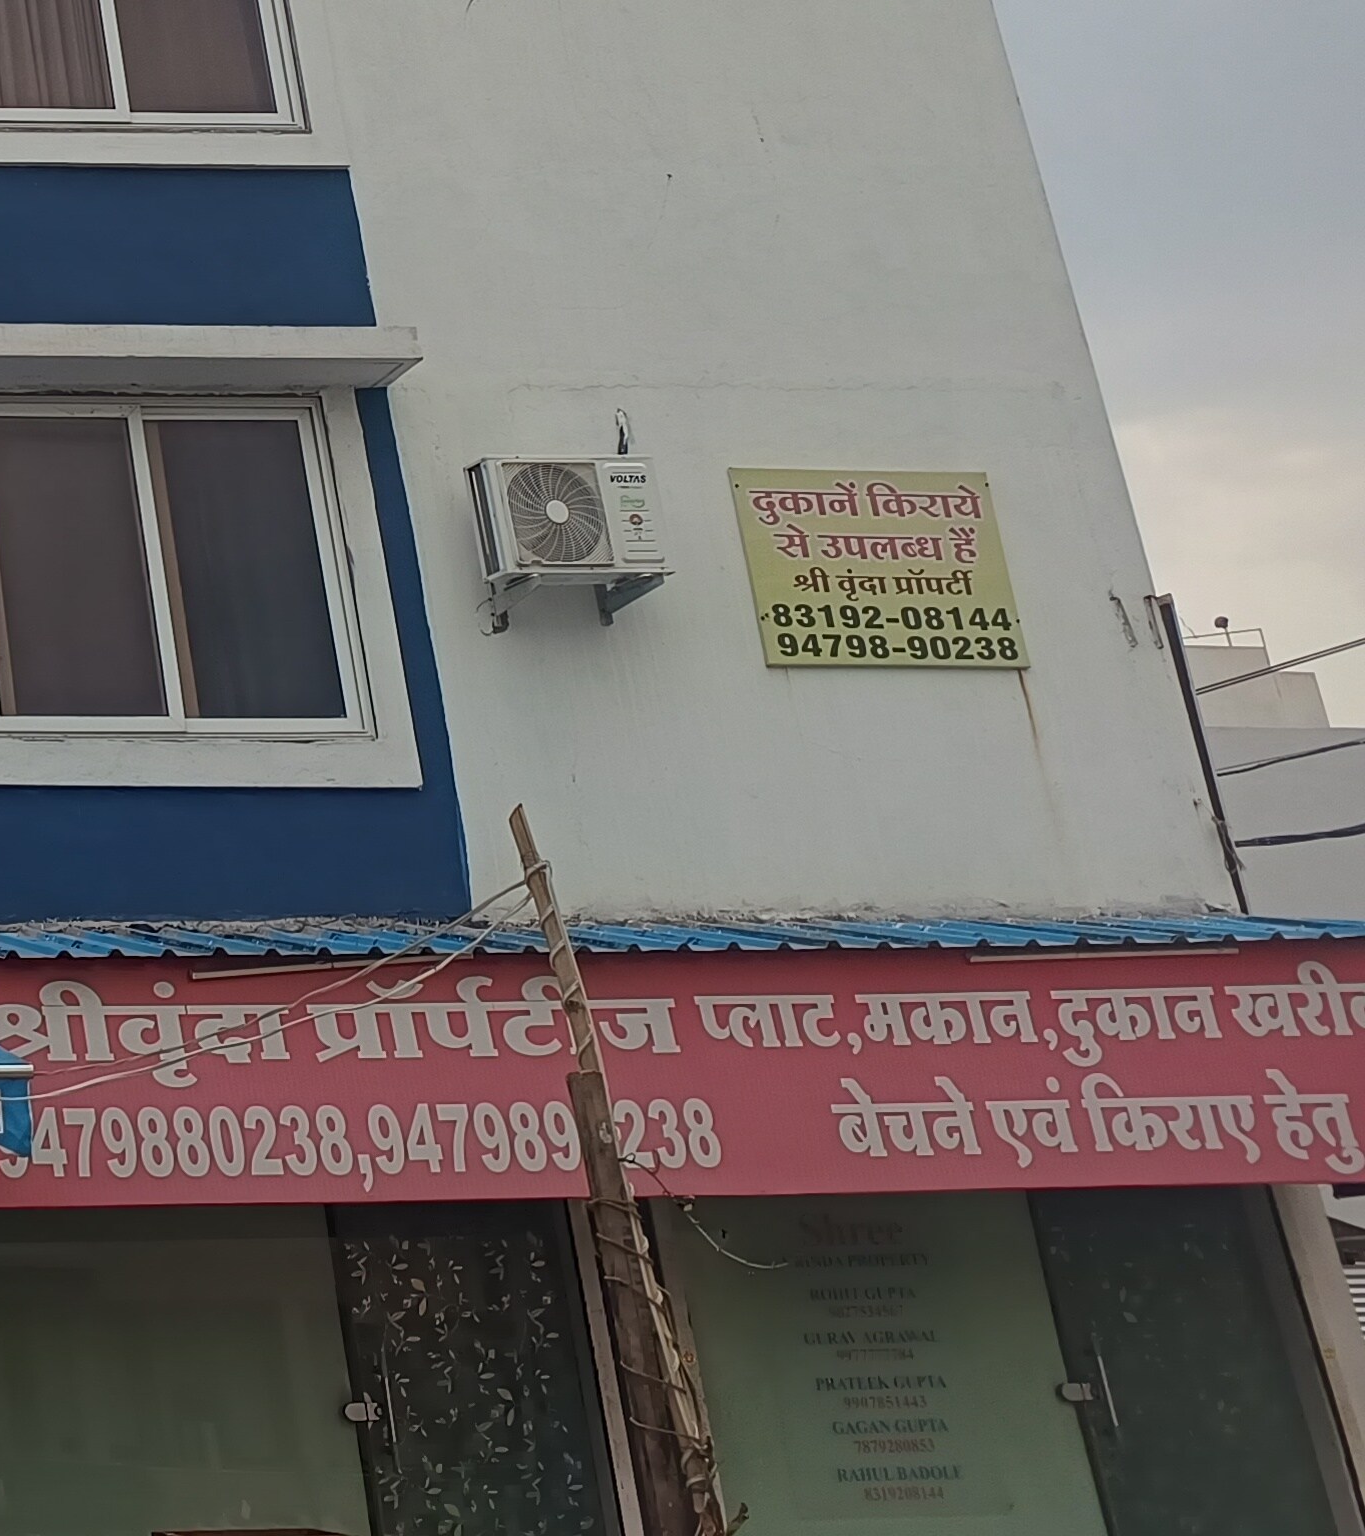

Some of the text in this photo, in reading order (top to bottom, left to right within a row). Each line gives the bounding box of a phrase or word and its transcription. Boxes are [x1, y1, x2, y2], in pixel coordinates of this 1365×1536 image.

[609, 474, 646, 484] VOLTAS
[749, 481, 982, 525] दुकानें किराये
[773, 524, 977, 563] से उपलब्ध हैं
[794, 566, 830, 593] श्री
[836, 568, 887, 601] वृंदा
[771, 603, 1012, 631] 83192-08144
[777, 632, 1019, 661] 94798-90238
[831, 1068, 1365, 1174] बेचने एवं किराए हेतु
[815, 1374, 947, 1392] PRATEEK GUPTA
[832, 1417, 950, 1435] GAGAN GUPTA
[837, 1466, 895, 1483] RAHUL
